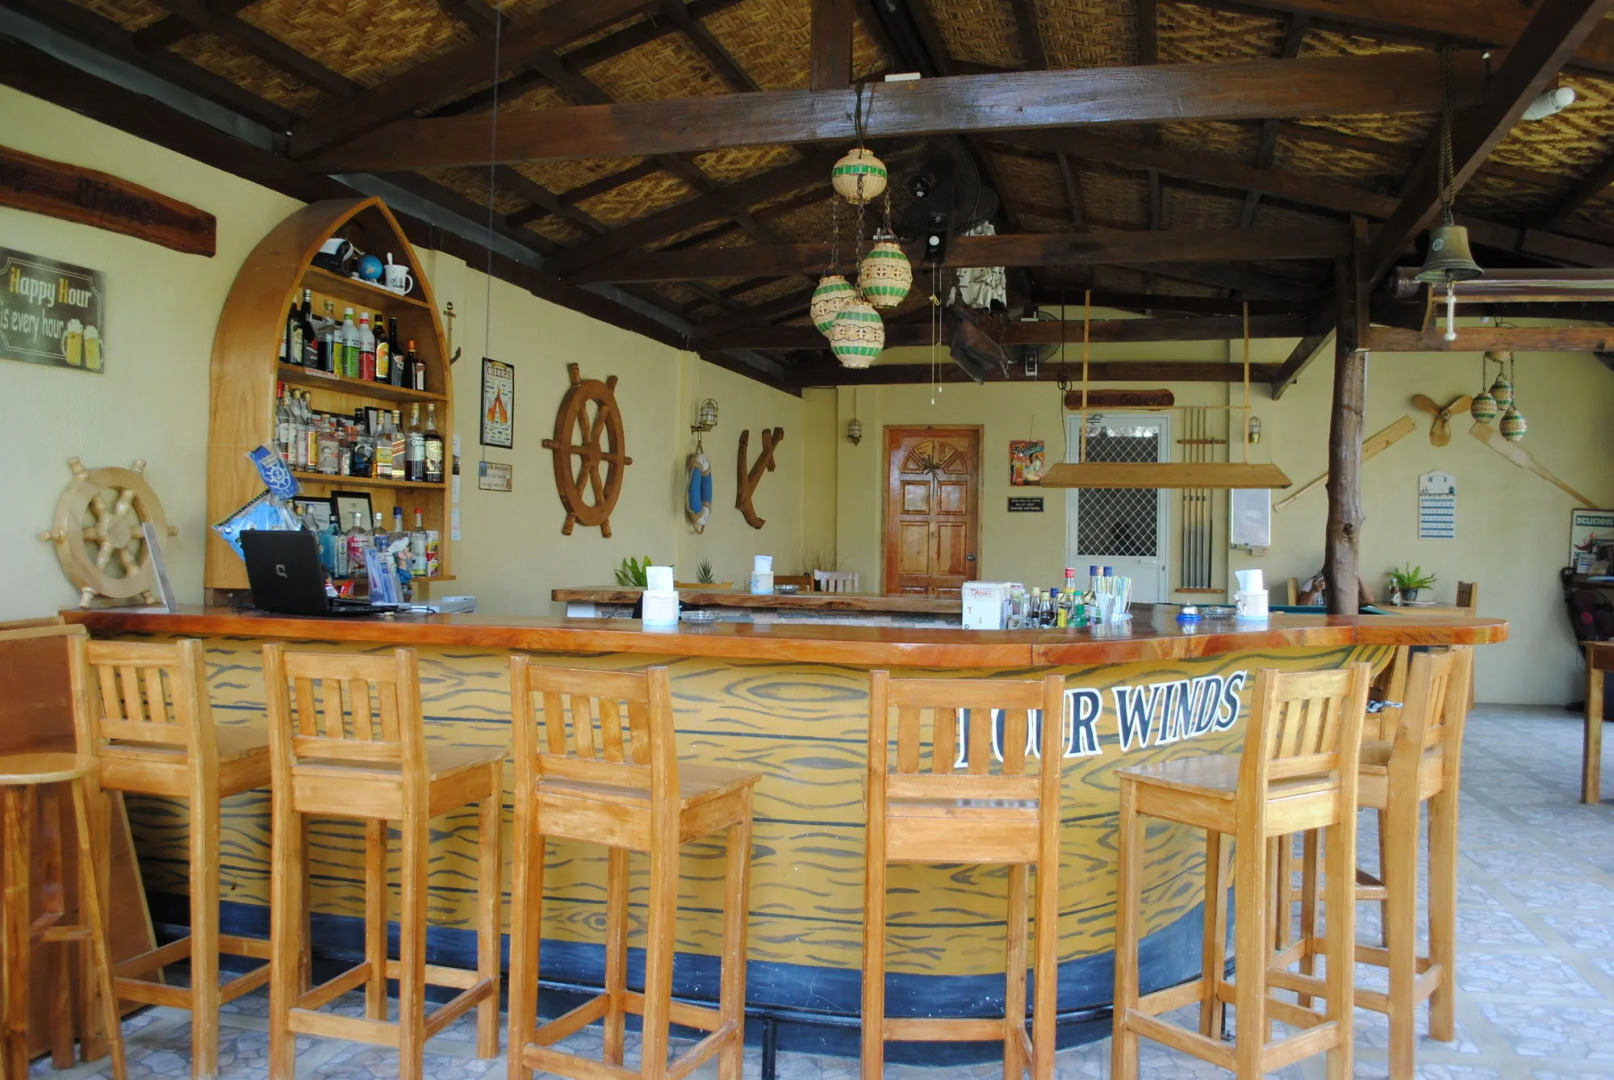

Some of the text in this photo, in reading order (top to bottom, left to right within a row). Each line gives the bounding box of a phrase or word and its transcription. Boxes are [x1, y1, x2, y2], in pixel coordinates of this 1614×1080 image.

[9, 267, 93, 309] Happy Hour
[11, 310, 40, 343] every
[42, 308, 64, 339] hour
[487, 366, 511, 380] CHEERS
[1576, 517, 1614, 526] DELICIOUS
[1112, 670, 1248, 753] WINDS
